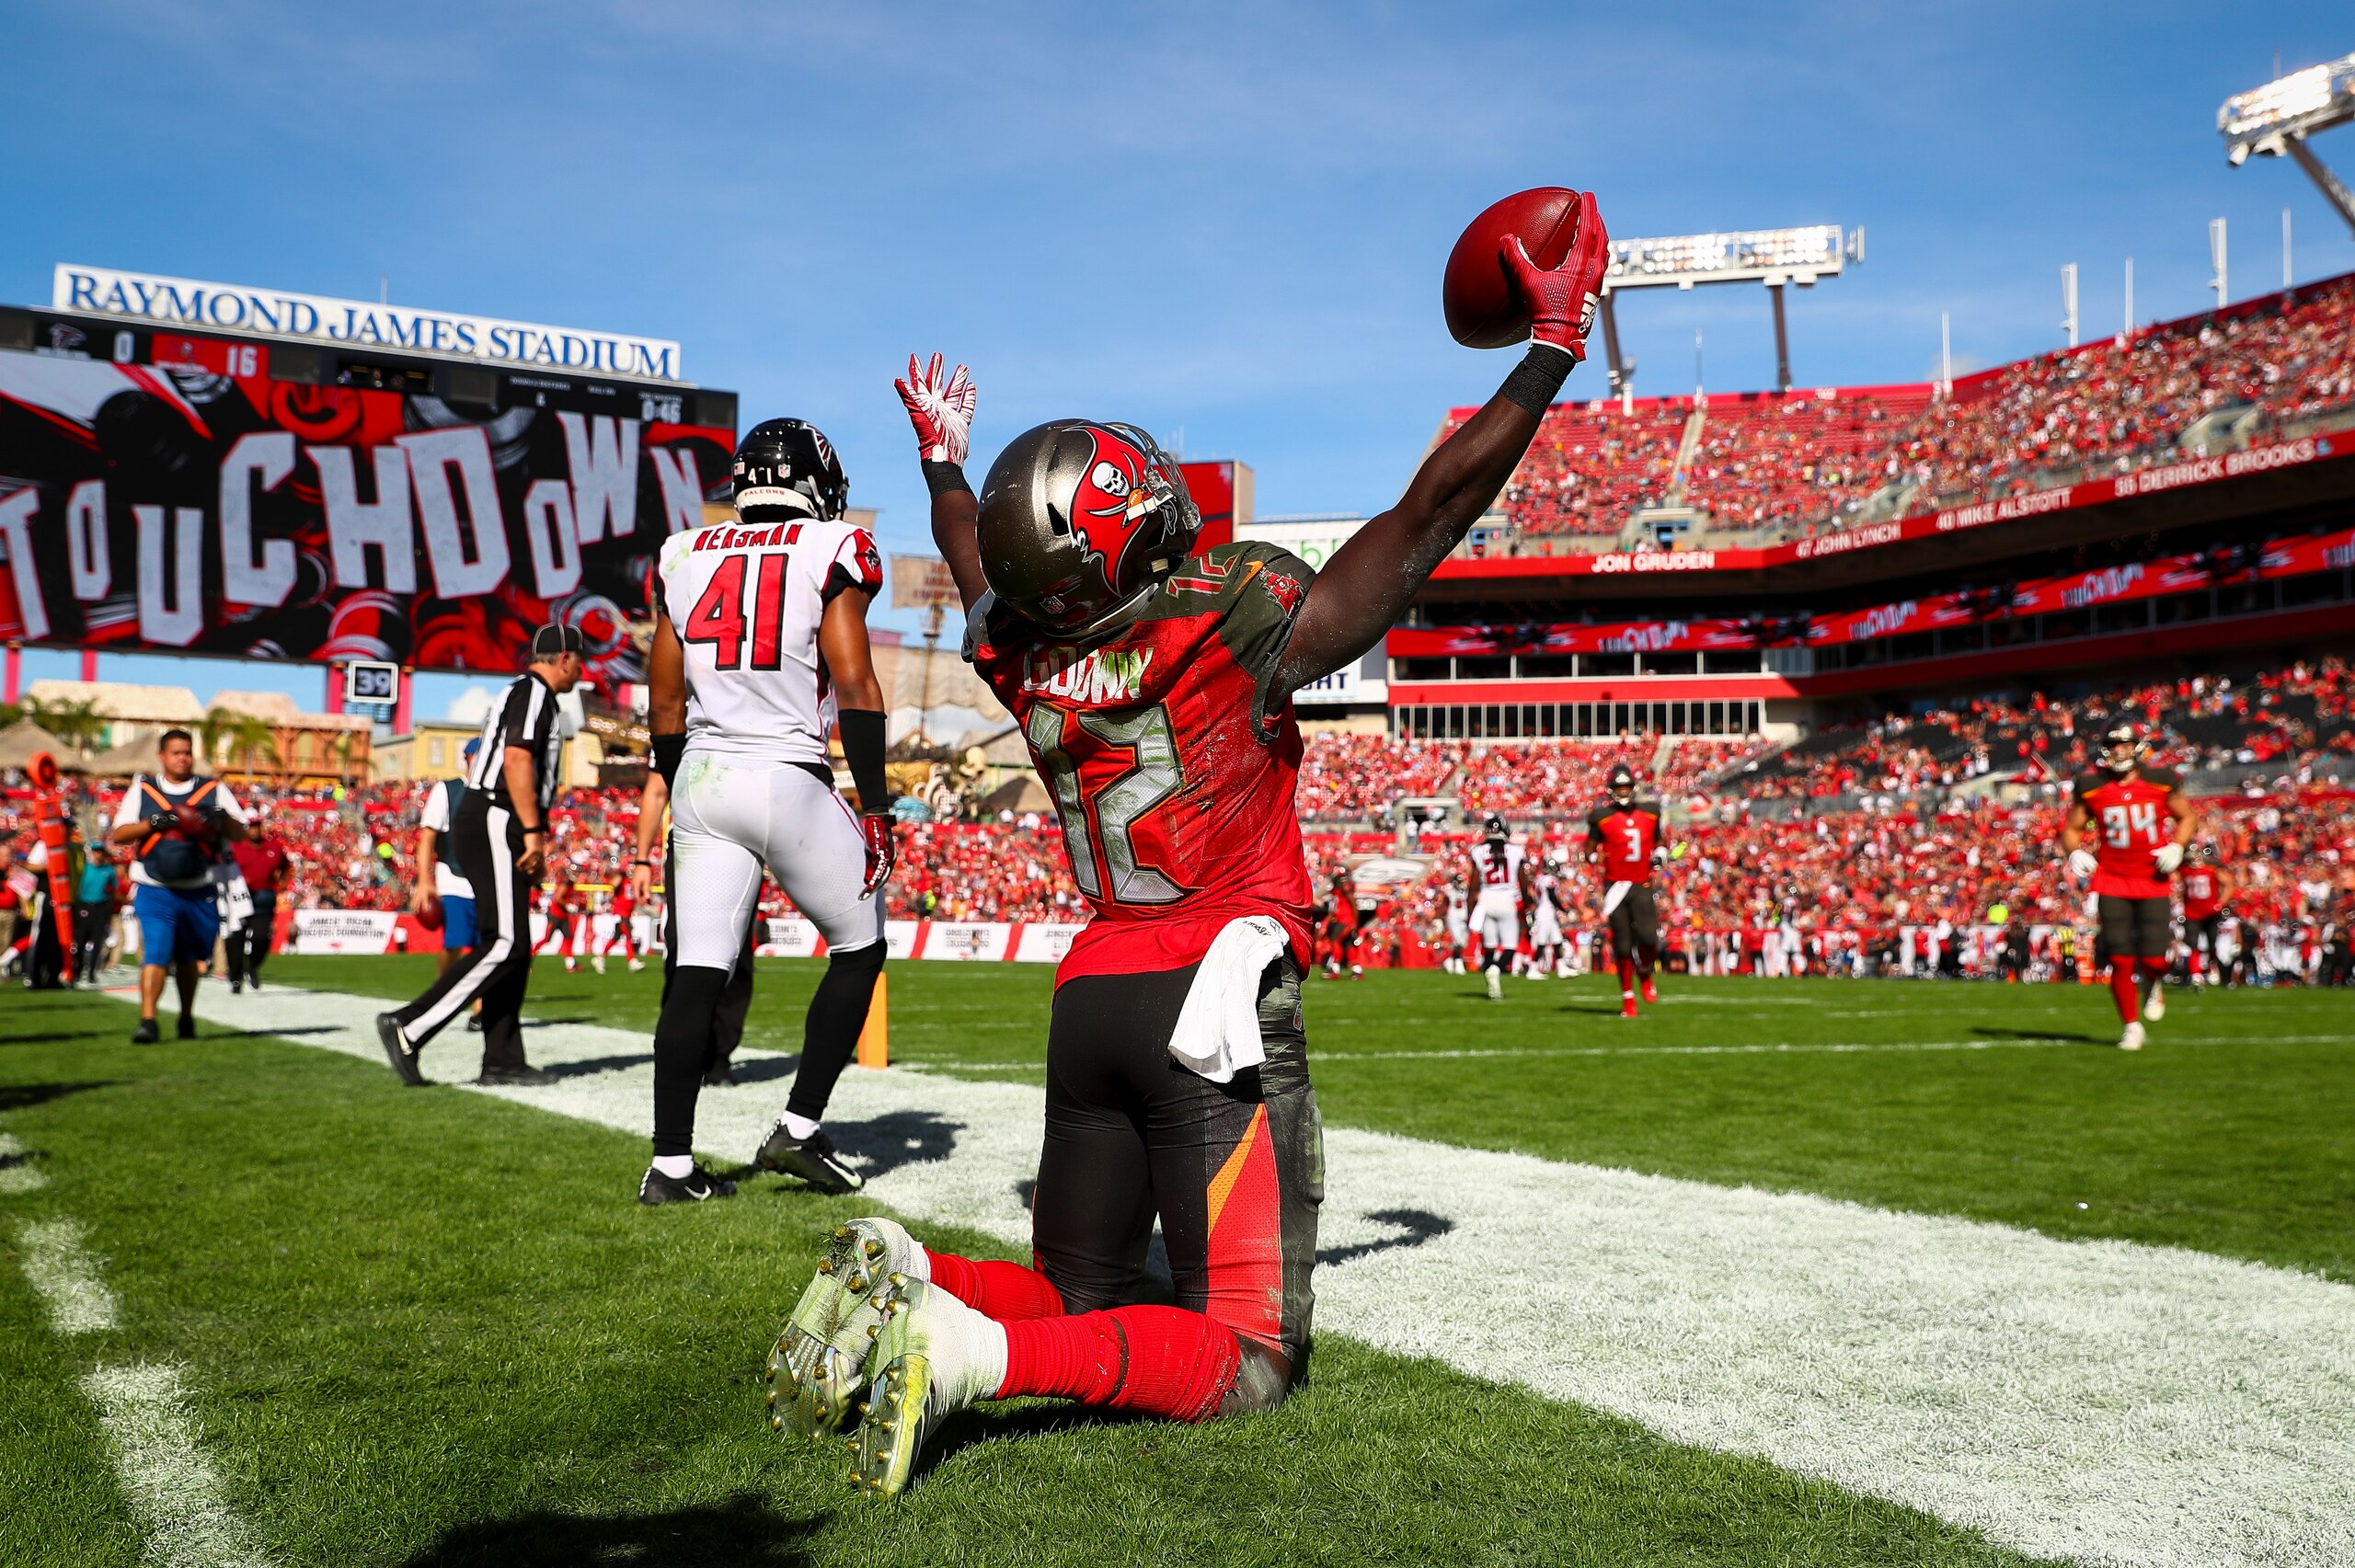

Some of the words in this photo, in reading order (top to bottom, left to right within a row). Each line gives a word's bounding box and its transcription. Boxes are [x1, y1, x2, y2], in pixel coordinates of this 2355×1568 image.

[69, 274, 319, 334] RAYMOND
[328, 309, 477, 354] JAMES
[490, 326, 674, 378] STADIUM
[114, 331, 134, 363] 0
[227, 345, 257, 377] 16
[747, 467, 772, 485] 41
[2115, 475, 2137, 498] 55
[2139, 459, 2224, 492] DERRICK
[2226, 439, 2316, 475] BROOKS
[744, 488, 785, 497] FALCONS
[1935, 509, 1956, 531] 40
[1957, 503, 1997, 528] MIKE
[1996, 486, 2074, 519] ALSTOTT
[0, 411, 705, 646] TOUCHDOWN
[692, 523, 804, 552] NEASMAN
[1813, 531, 1851, 556] JOHN
[1853, 523, 1902, 549] LYNCH
[1591, 554, 1632, 573] JON
[1633, 551, 1716, 571] GRUDEN
[684, 553, 789, 671] 41
[355, 670, 391, 696] 39
[1027, 702, 1201, 908] 12
[2102, 802, 2158, 849] 94
[1623, 829, 1641, 863] 3
[1485, 857, 1509, 885] 21
